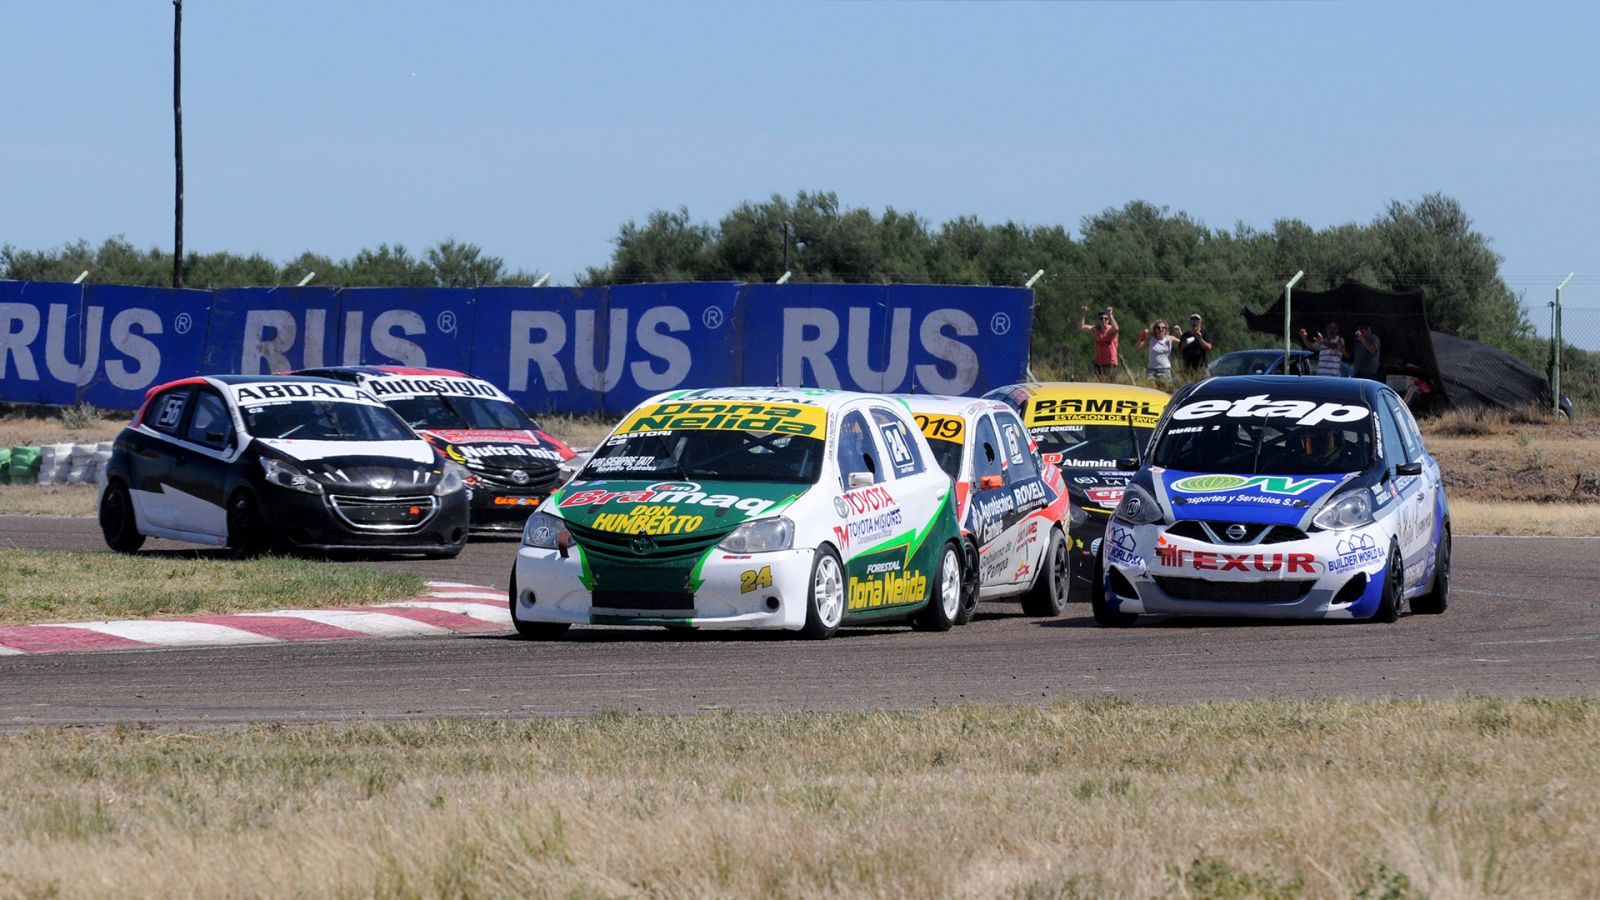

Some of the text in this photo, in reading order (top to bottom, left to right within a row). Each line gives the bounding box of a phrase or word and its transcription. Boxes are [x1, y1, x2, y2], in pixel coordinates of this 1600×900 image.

[0, 302, 163, 390] RUS
[241, 309, 427, 375] RUS
[508, 305, 692, 391] RUS
[782, 306, 978, 396] RUS
[367, 378, 498, 397] Autosiglo
[650, 401, 802, 418] Doña
[1035, 399, 1160, 416] RAMAL
[1172, 394, 1369, 426] etap
[628, 414, 817, 435] Nelida
[457, 445, 527, 460] Nutral
[558, 489, 775, 516] Bramaq
[629, 505, 675, 516] DON
[842, 486, 896, 515] TOYOTA
[1236, 494, 1281, 505] Servicios
[591, 513, 704, 536] HUMBERTO
[849, 517, 874, 537] TOYOTA
[867, 560, 900, 574] FORESTAL
[1328, 554, 1358, 572] BUILDER
[1357, 548, 1378, 562] WORLD
[741, 564, 773, 594] 24
[848, 569, 927, 610] Doña Nelida
